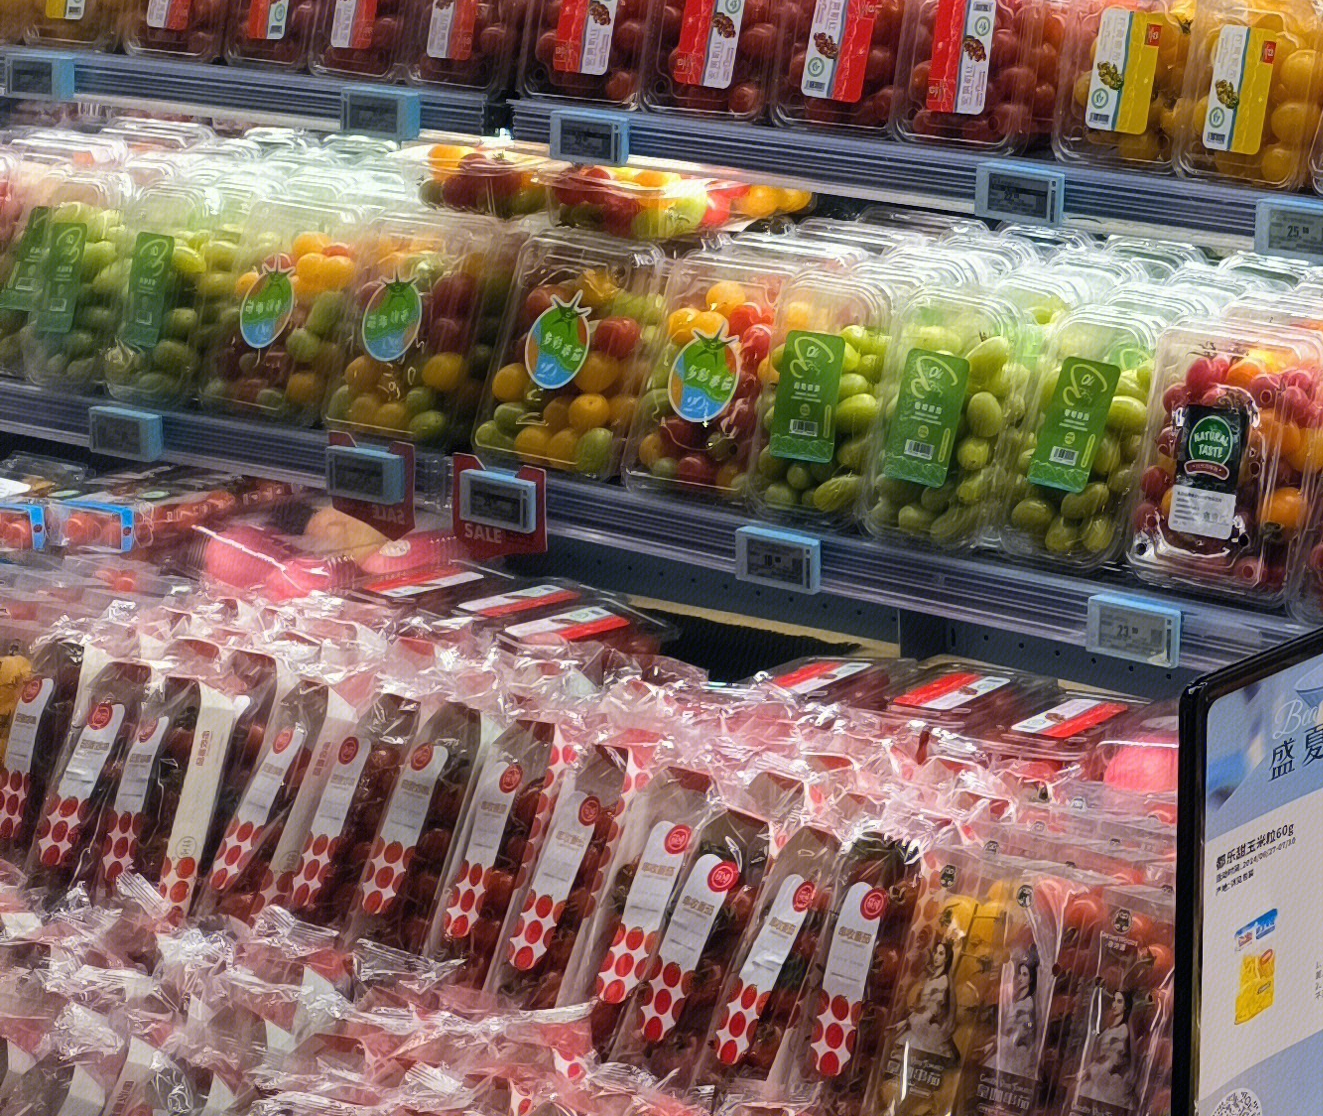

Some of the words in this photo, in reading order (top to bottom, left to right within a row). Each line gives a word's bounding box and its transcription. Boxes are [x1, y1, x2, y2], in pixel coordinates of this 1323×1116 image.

[1193, 430, 1229, 447] NATURAL
[1198, 443, 1224, 458] TASTE
[464, 523, 502, 544] SALE
[1215, 822, 1295, 871] 都乐甜玉米粒60g
